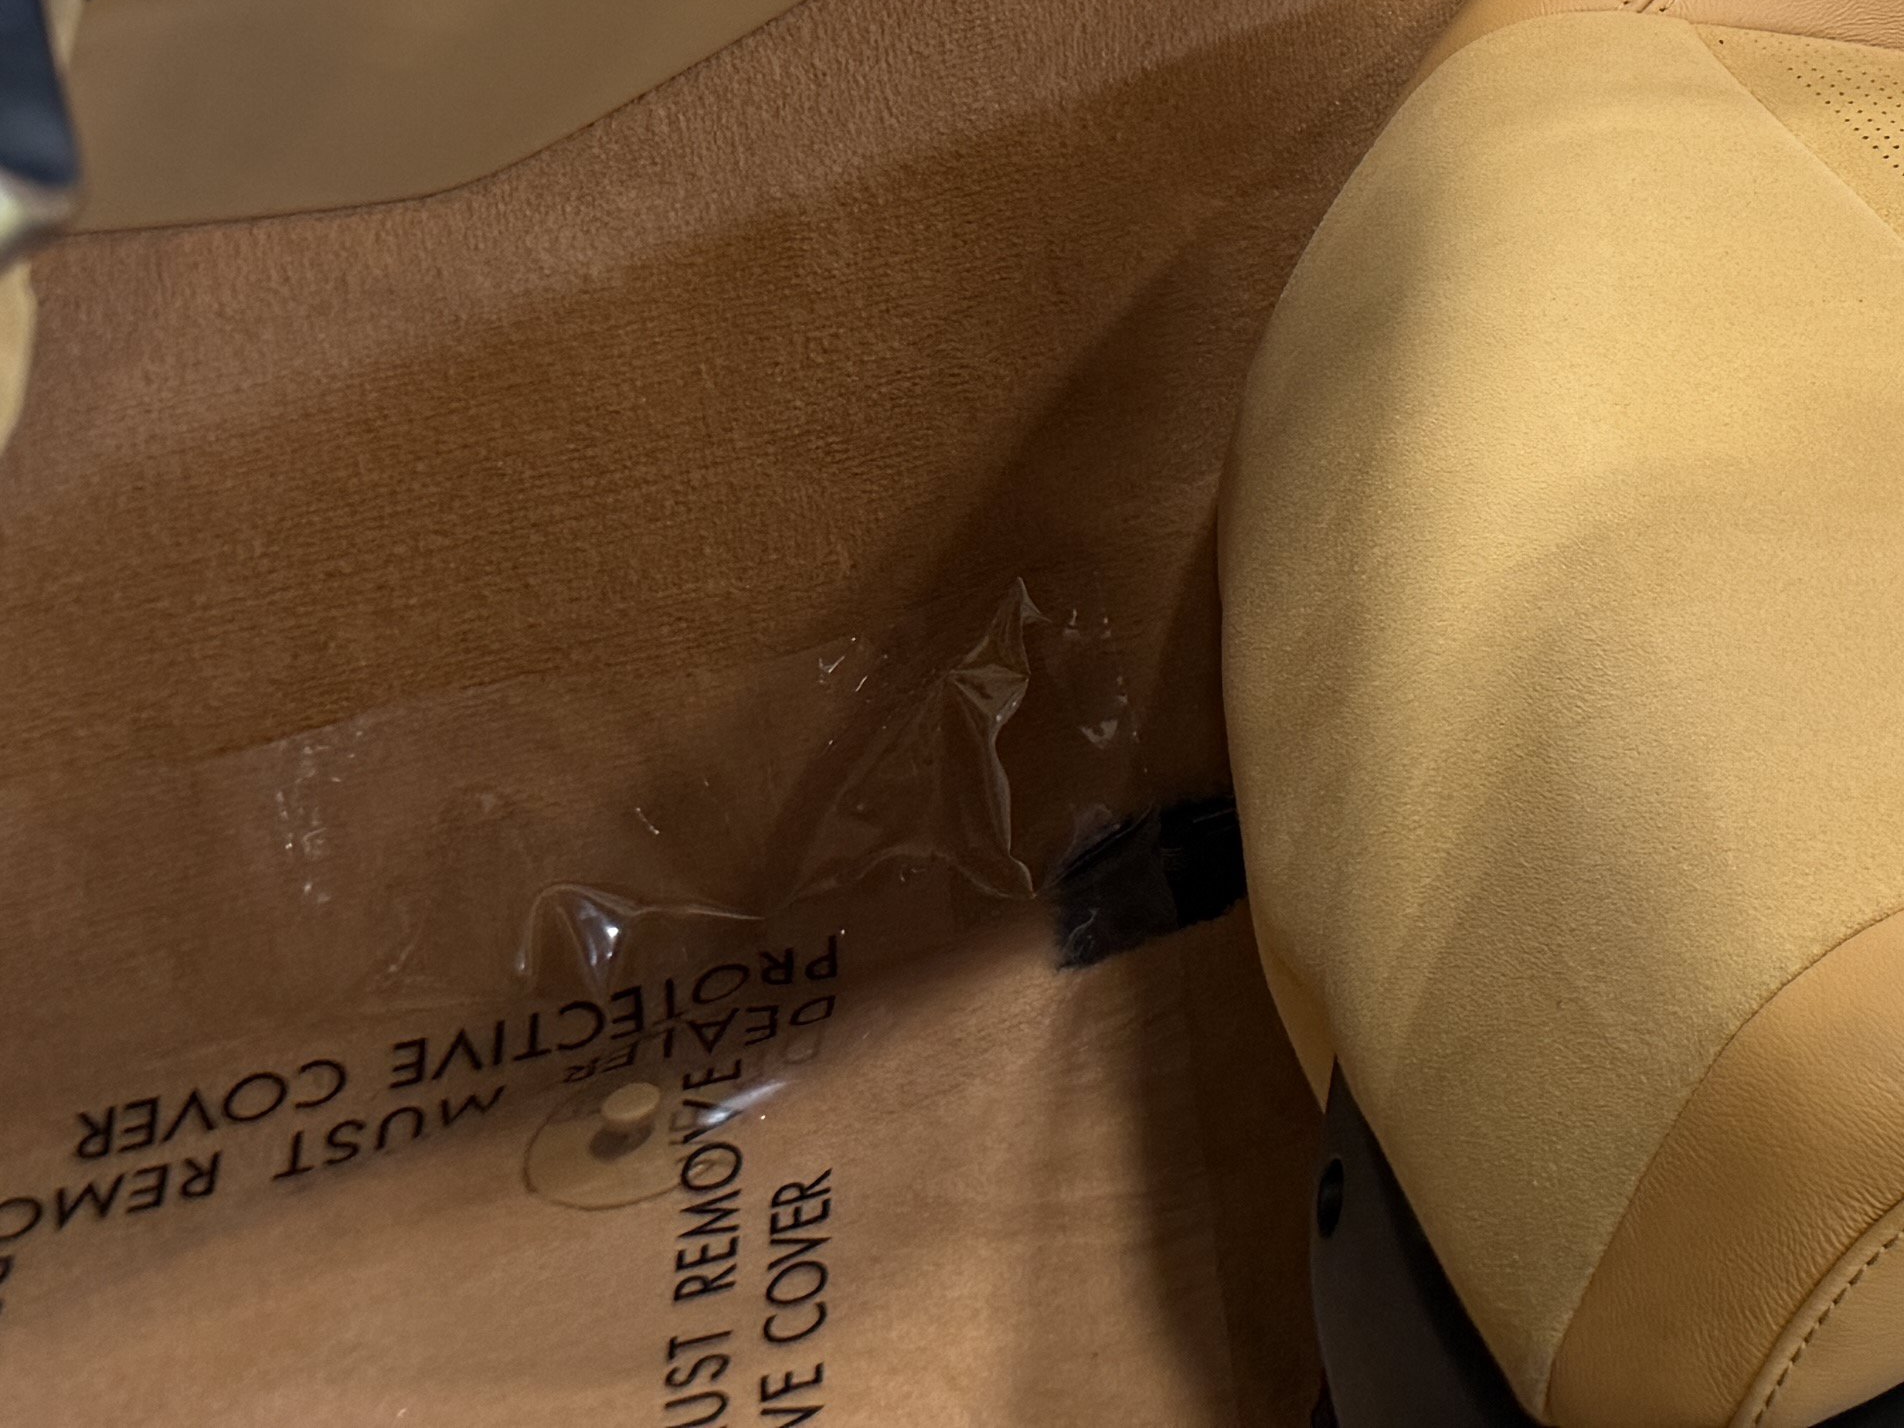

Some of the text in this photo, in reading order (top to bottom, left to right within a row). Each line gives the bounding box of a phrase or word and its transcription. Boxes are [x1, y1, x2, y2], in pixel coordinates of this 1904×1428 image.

[73, 935, 838, 1160] PROTECTIVE COVER
[563, 994, 837, 1084] DEALER
[272, 1085, 505, 1181] MUST
[674, 1059, 743, 1303] REMOVE
[763, 1167, 833, 1344] COVER
